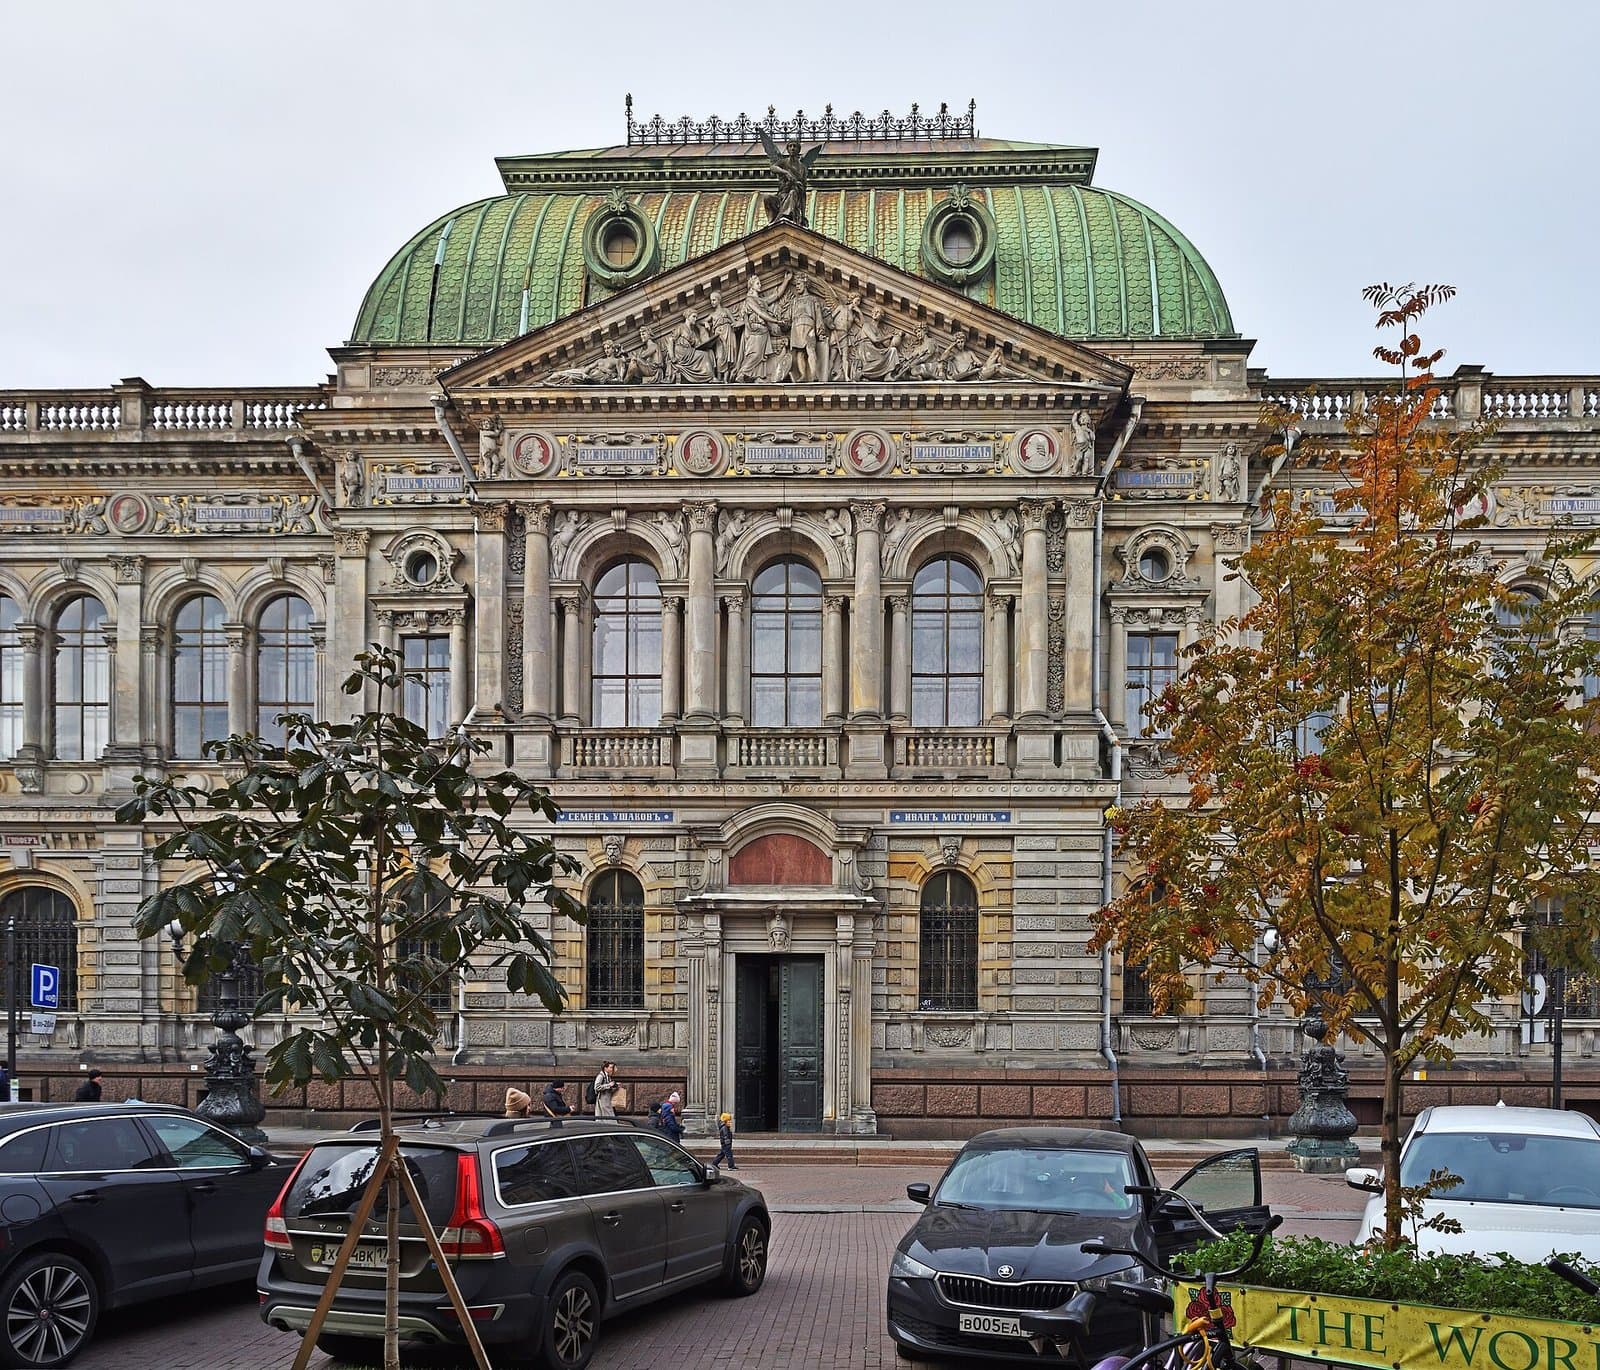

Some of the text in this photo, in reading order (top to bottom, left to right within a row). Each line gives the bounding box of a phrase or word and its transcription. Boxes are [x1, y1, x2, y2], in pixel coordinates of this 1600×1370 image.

[568, 812, 661, 821] СЕМЕНЪ УШАКОВЪ
[904, 812, 996, 822] ИВАНЪ МОТОРИНЪ
[39, 970, 54, 1002] P
[1276, 1302, 1387, 1357] THE
